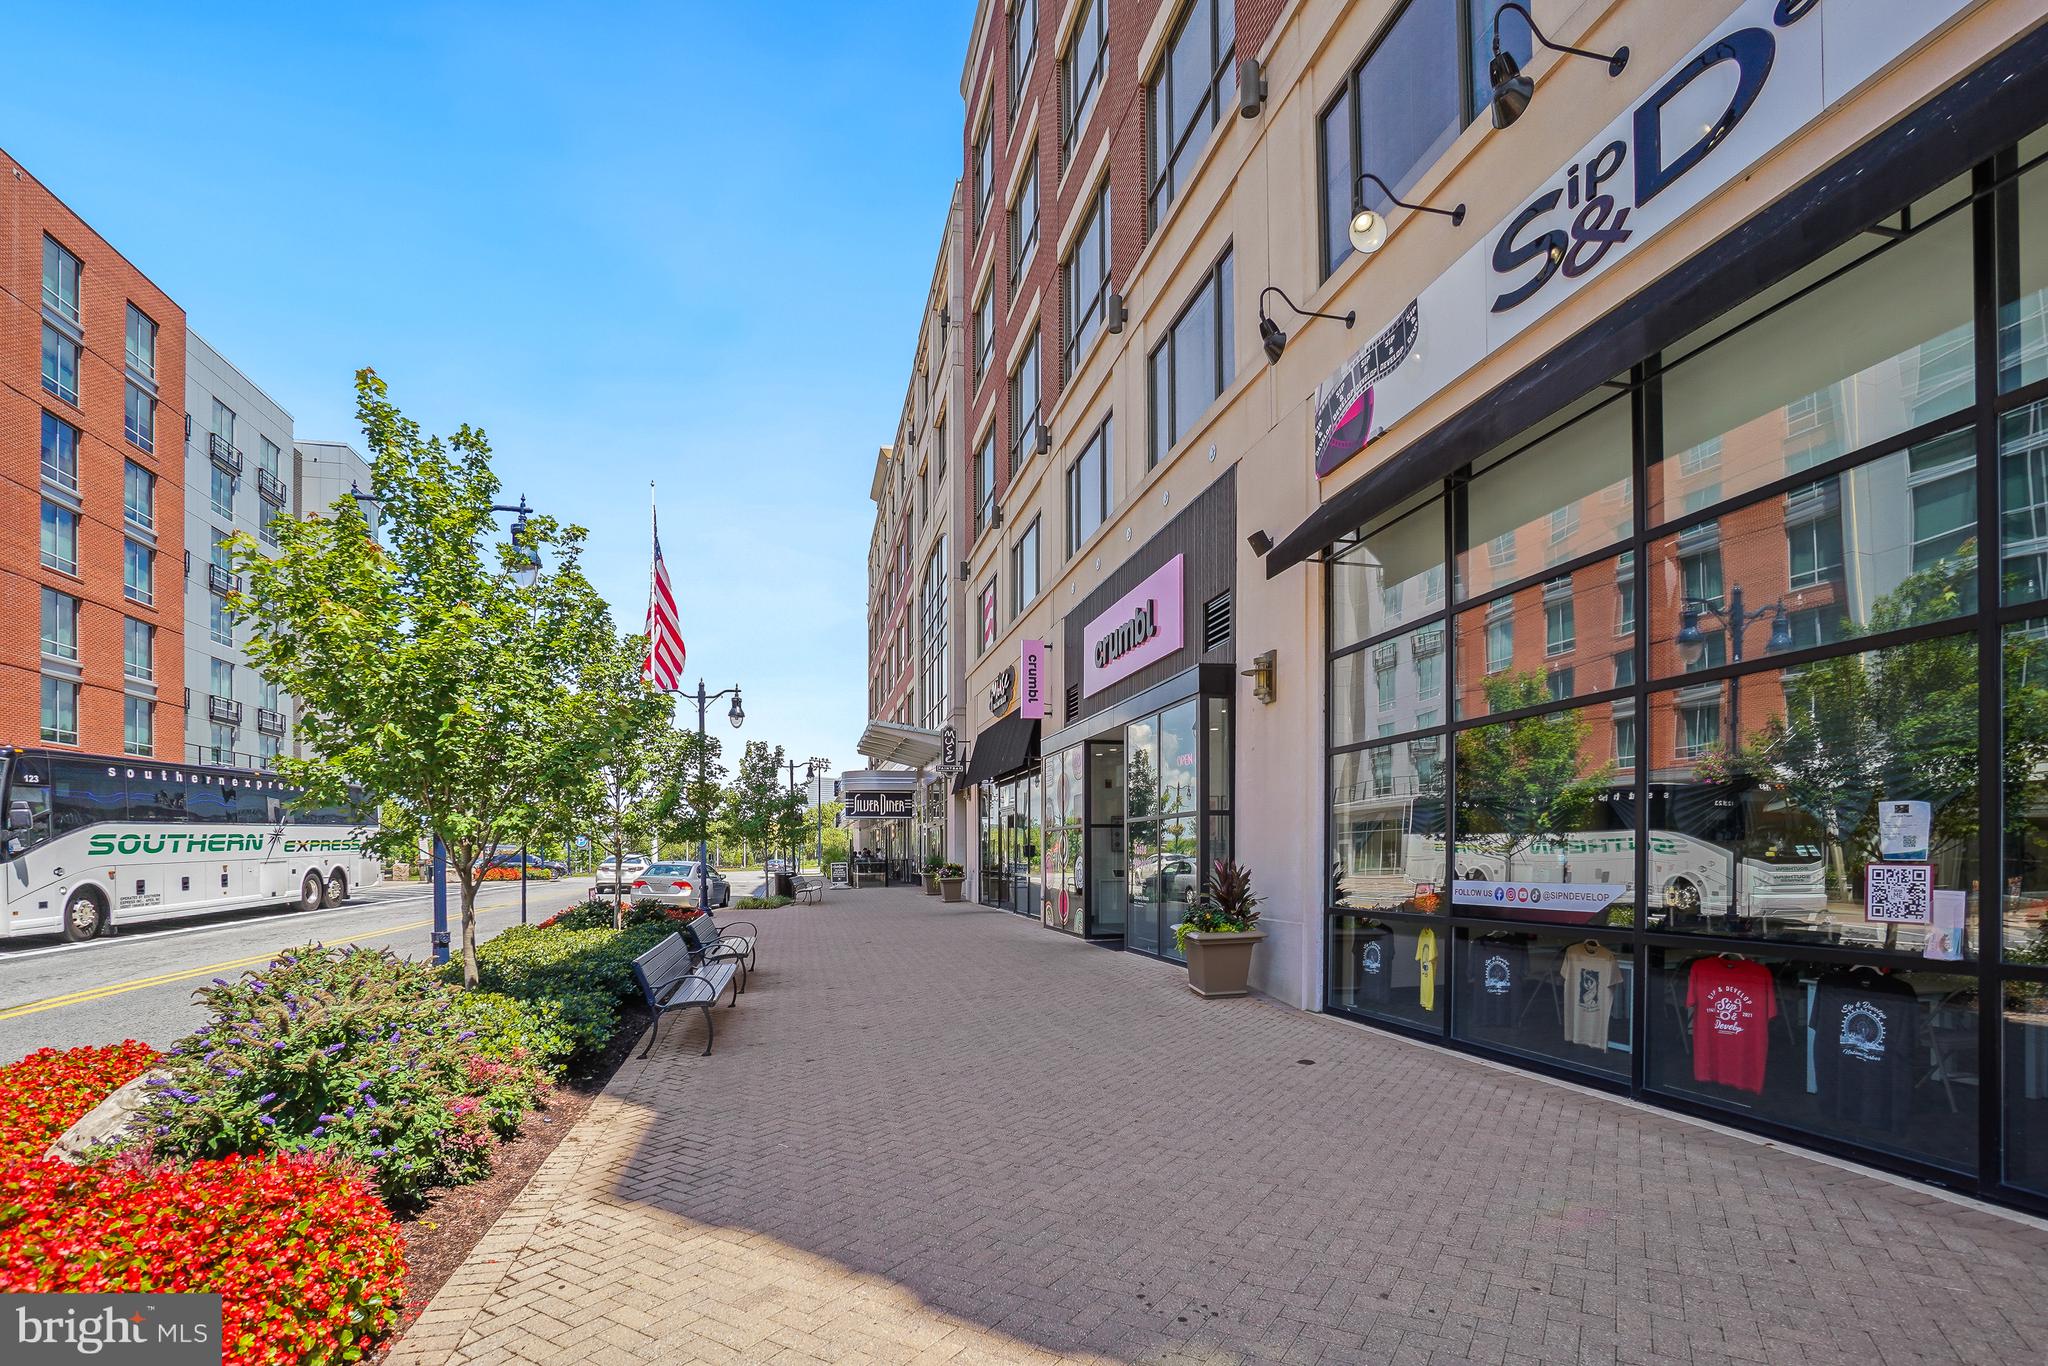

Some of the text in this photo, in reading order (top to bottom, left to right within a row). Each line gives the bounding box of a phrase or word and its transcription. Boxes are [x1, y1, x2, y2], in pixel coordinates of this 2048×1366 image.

[1490, 139, 1627, 313] Sip
[1561, 194, 1633, 279] &
[1384, 334, 1395, 348] SIP
[1360, 354, 1371, 369] SIP
[1380, 345, 1404, 371] DEVELOP
[1355, 367, 1378, 389] DEVELOP
[1335, 382, 1346, 399] SIP
[1332, 388, 1355, 421] DEVELOP
[1314, 423, 1332, 457] DEVELOP
[1095, 599, 1157, 669] crumbl
[1028, 654, 1038, 704] crumbl
[1177, 753, 1193, 766] OPEN
[24, 774, 40, 784] 123
[88, 834, 361, 856] SOUTHERN EXPRESS
[1454, 888, 1610, 902] FOLLOW US @SIPNDEVELOP
[1717, 997, 1738, 1013] Sip
[1725, 985, 1753, 1005] DEVELOP
[1714, 1019, 1745, 1035] Develop
